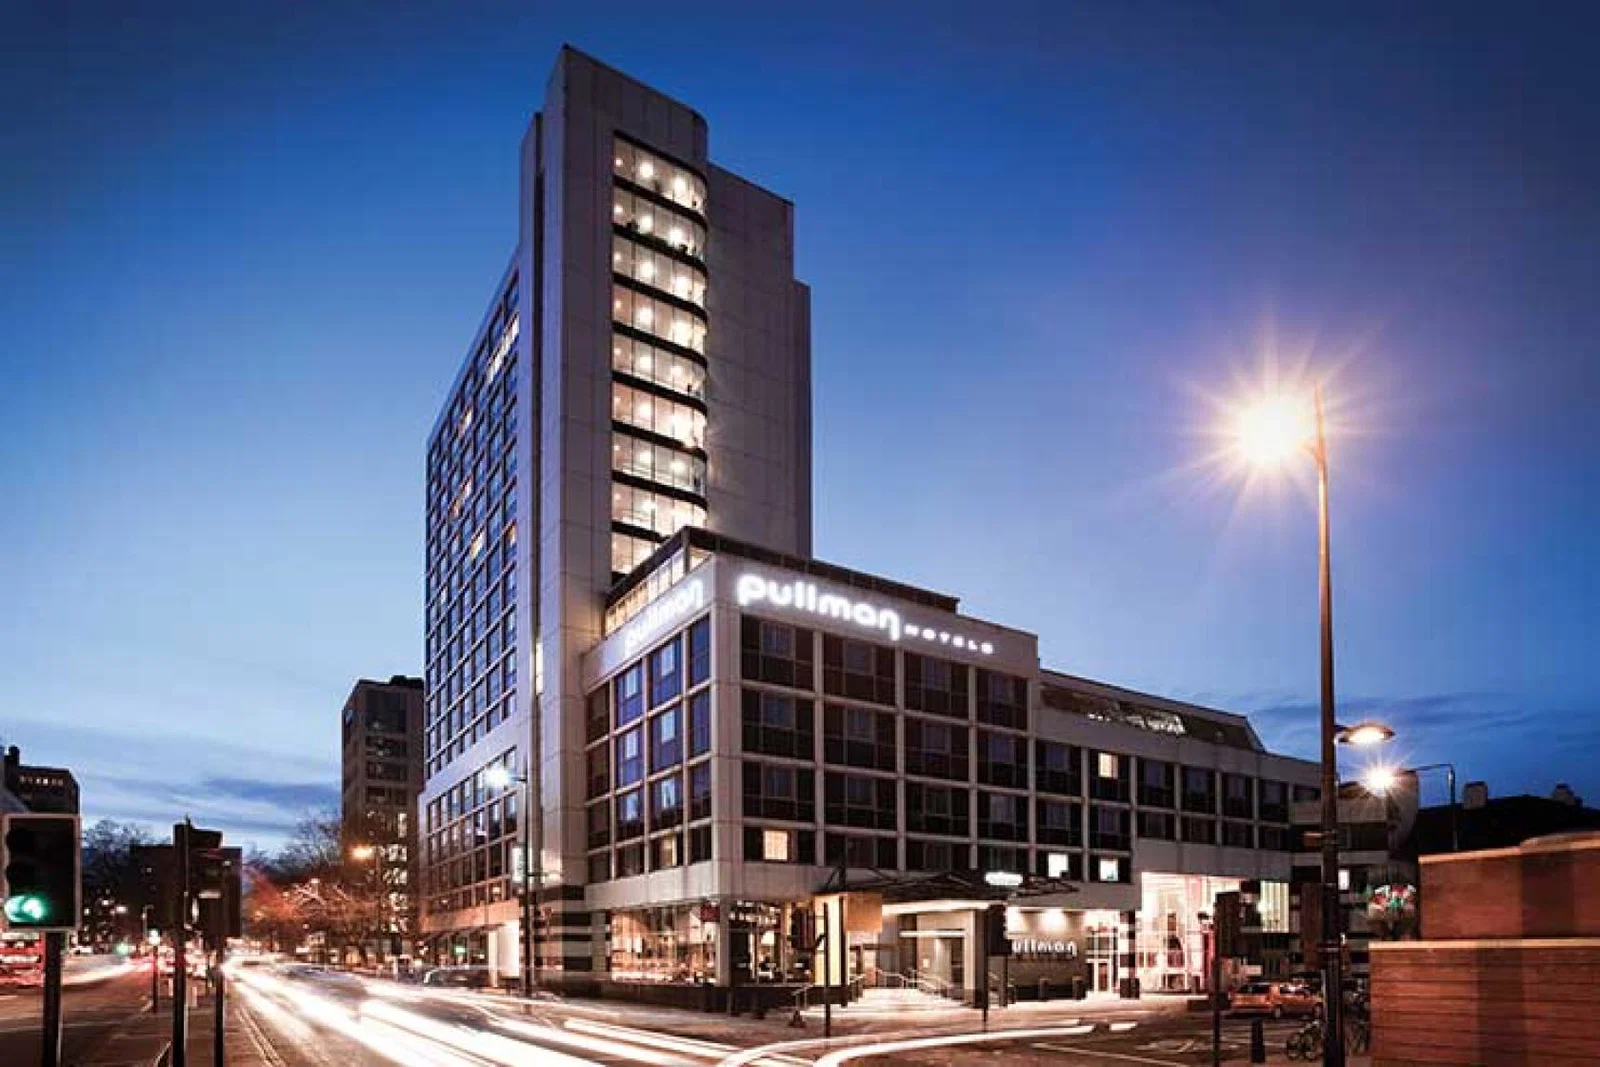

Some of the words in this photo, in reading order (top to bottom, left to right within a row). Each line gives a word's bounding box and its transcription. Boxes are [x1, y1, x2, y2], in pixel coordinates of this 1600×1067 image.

[736, 574, 900, 641] pullman
[904, 624, 994, 655] HOTELS
[1011, 938, 1077, 957] ullman
